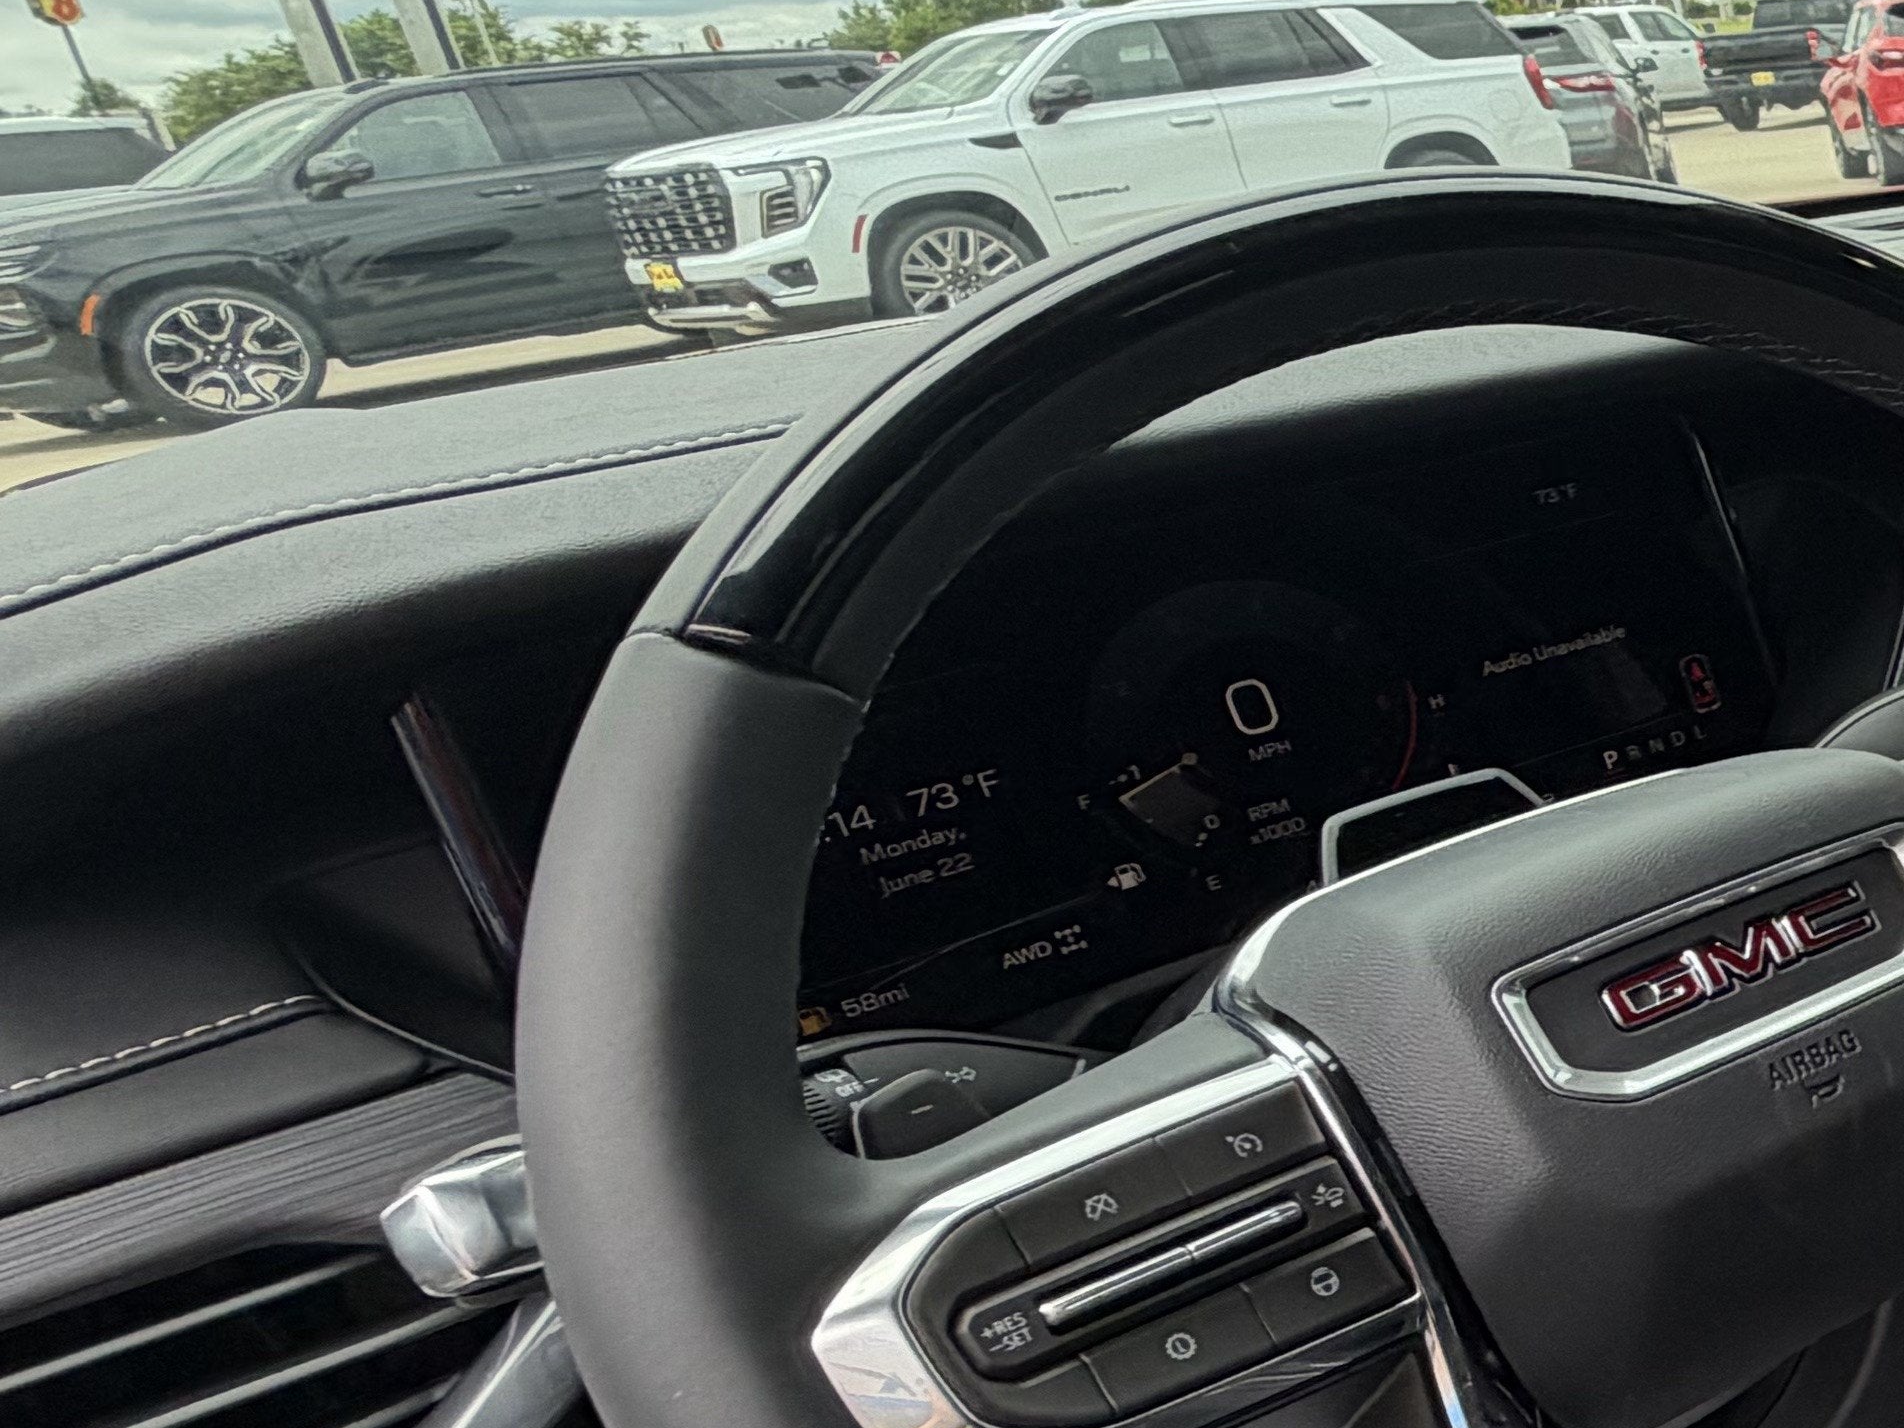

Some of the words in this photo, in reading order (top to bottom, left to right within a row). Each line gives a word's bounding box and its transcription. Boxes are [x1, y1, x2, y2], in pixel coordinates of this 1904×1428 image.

[1483, 640, 1532, 676] Audio
[1532, 624, 1626, 661] Unavailable
[1225, 678, 1279, 735] 0
[1248, 740, 1293, 762] MPH
[1603, 750, 1619, 770] P
[1670, 730, 1687, 747] D
[1246, 798, 1292, 822] RPM
[878, 870, 936, 900] June
[936, 852, 976, 878] 22
[1204, 874, 1223, 892] E
[1003, 939, 1053, 970] AWD
[1600, 880, 1882, 1035] GMC
[1765, 1028, 1863, 1091] AIRBAG
